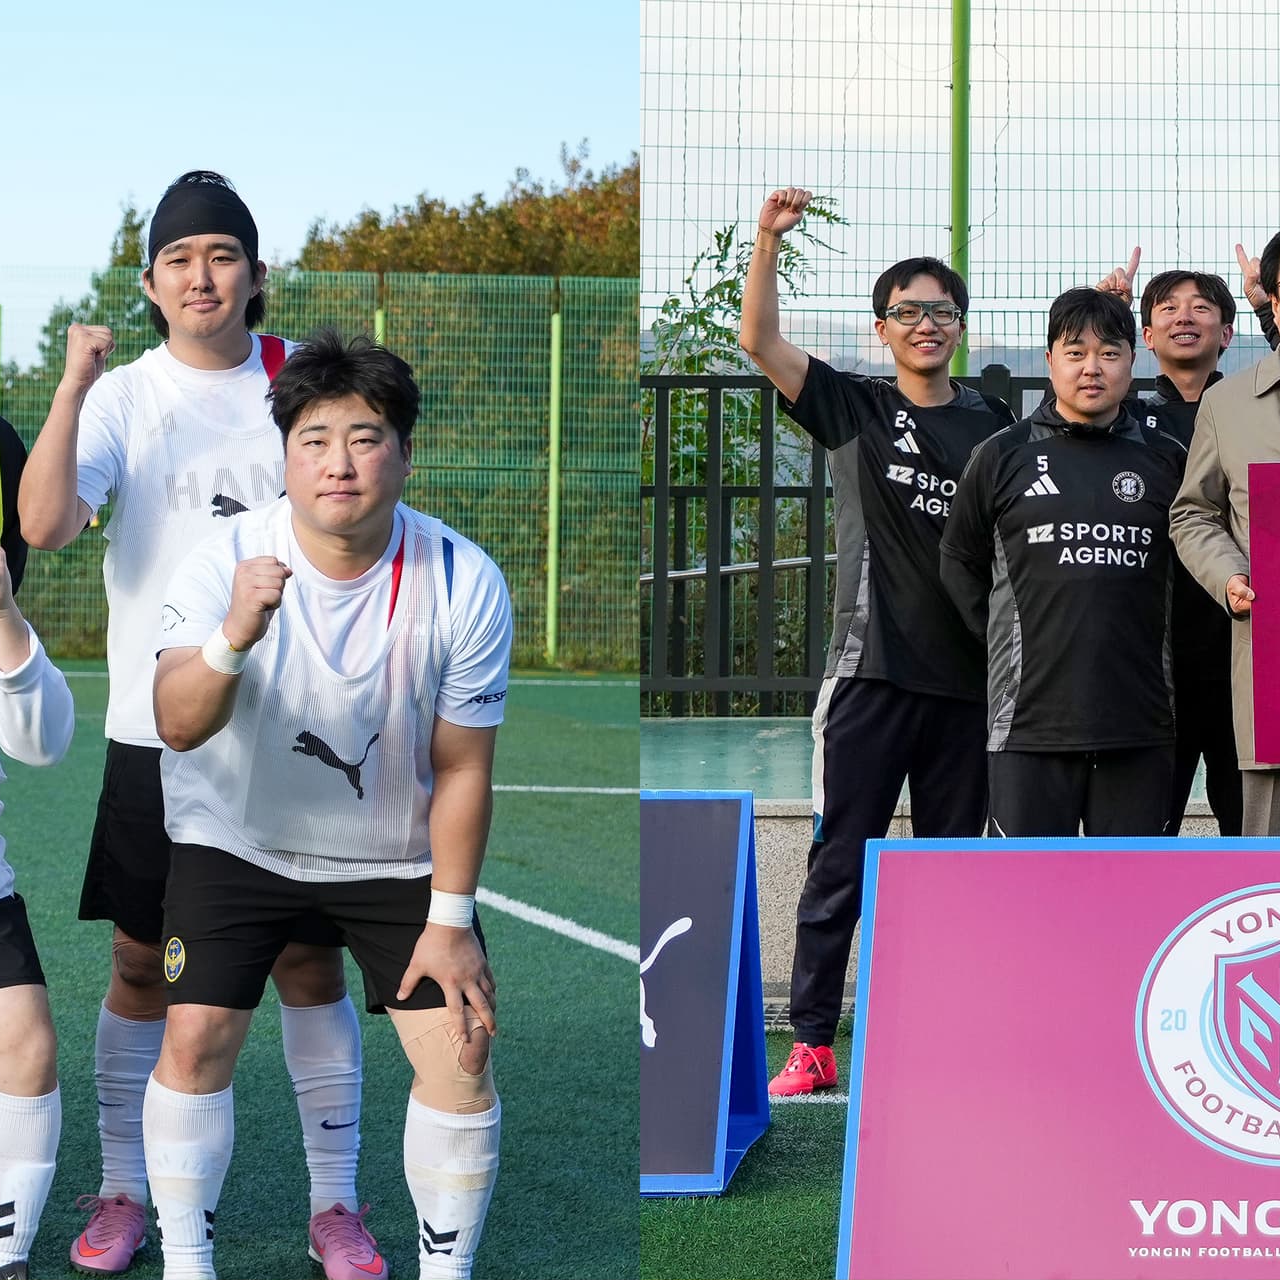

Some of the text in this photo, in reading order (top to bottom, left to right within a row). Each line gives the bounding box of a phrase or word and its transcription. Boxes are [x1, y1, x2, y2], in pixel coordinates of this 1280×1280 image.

[894, 410, 917, 430] 24
[1146, 416, 1157, 428] 6
[1036, 455, 1048, 472] 5
[1060, 523, 1153, 545] SPORTS
[1058, 547, 1149, 569] AGENCY
[1160, 1009, 1187, 1031] 20
[1128, 1247, 1192, 1258] YONGIN
